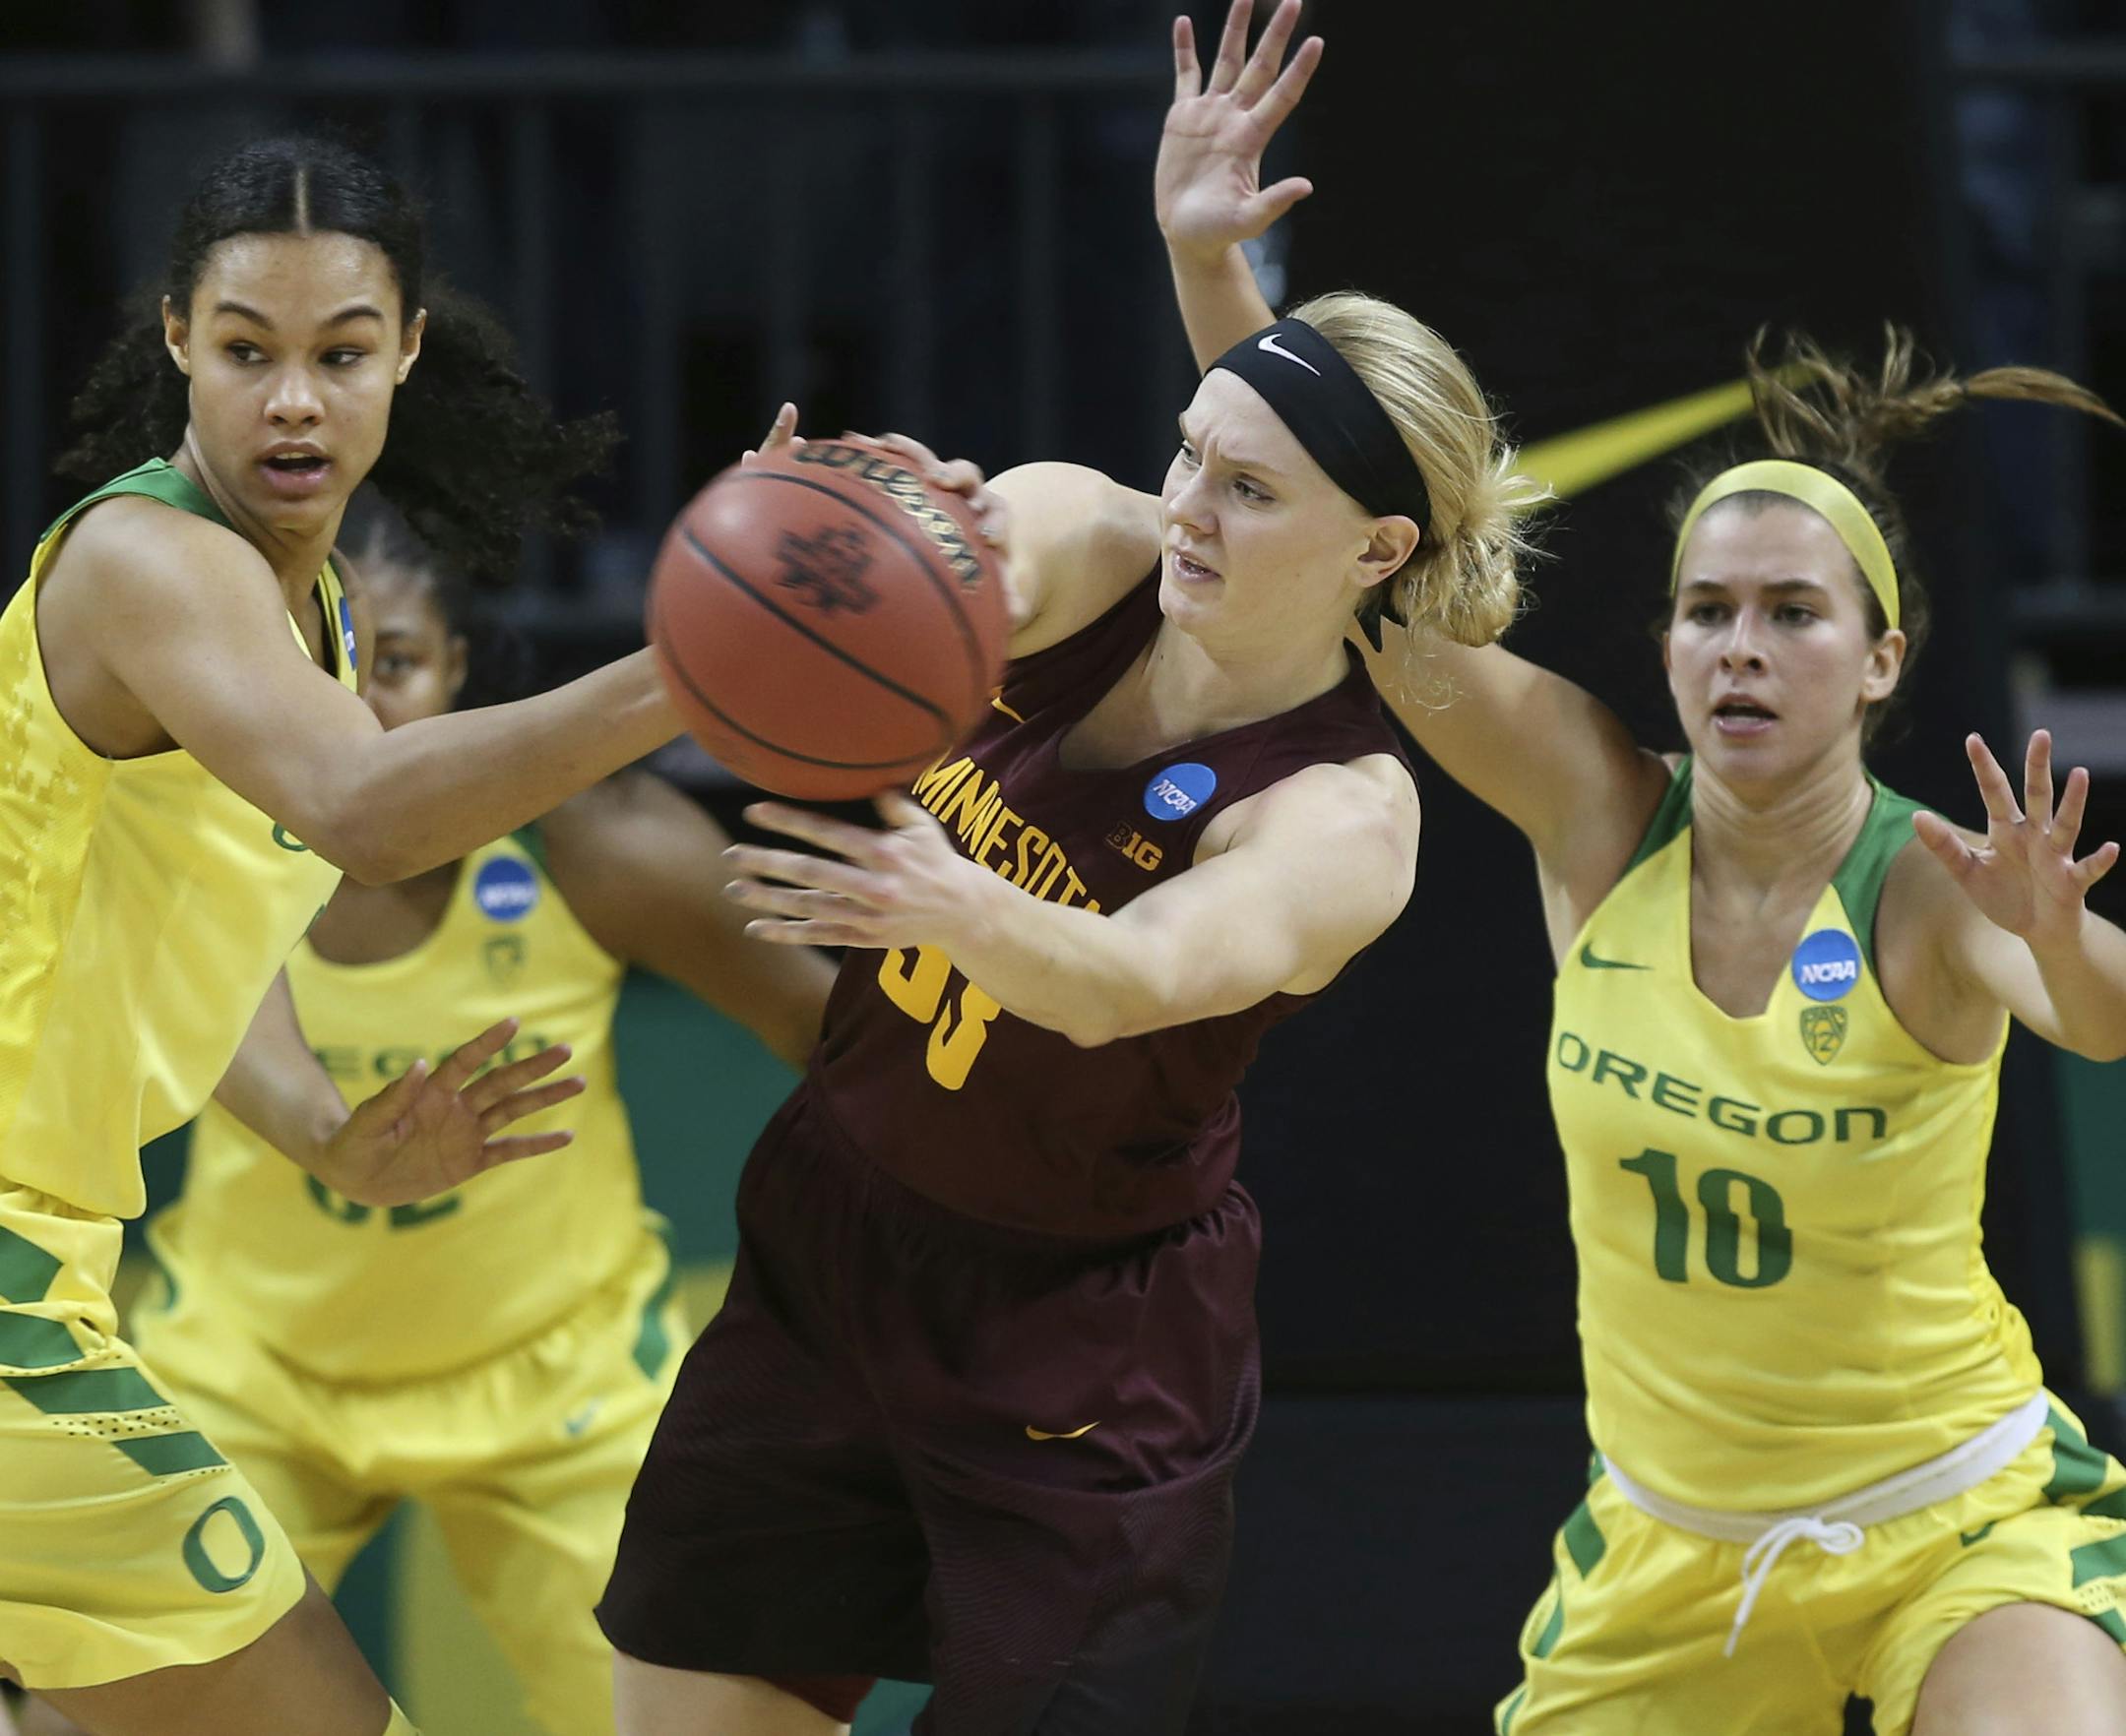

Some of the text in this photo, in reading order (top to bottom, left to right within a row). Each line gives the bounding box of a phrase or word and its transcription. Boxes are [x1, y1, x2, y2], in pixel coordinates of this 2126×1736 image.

[1153, 778, 1197, 815] NCAA
[1800, 960, 1856, 984] NCAA
[1557, 1031, 1887, 1145] OREGON
[1619, 1147, 1792, 1288] 10
